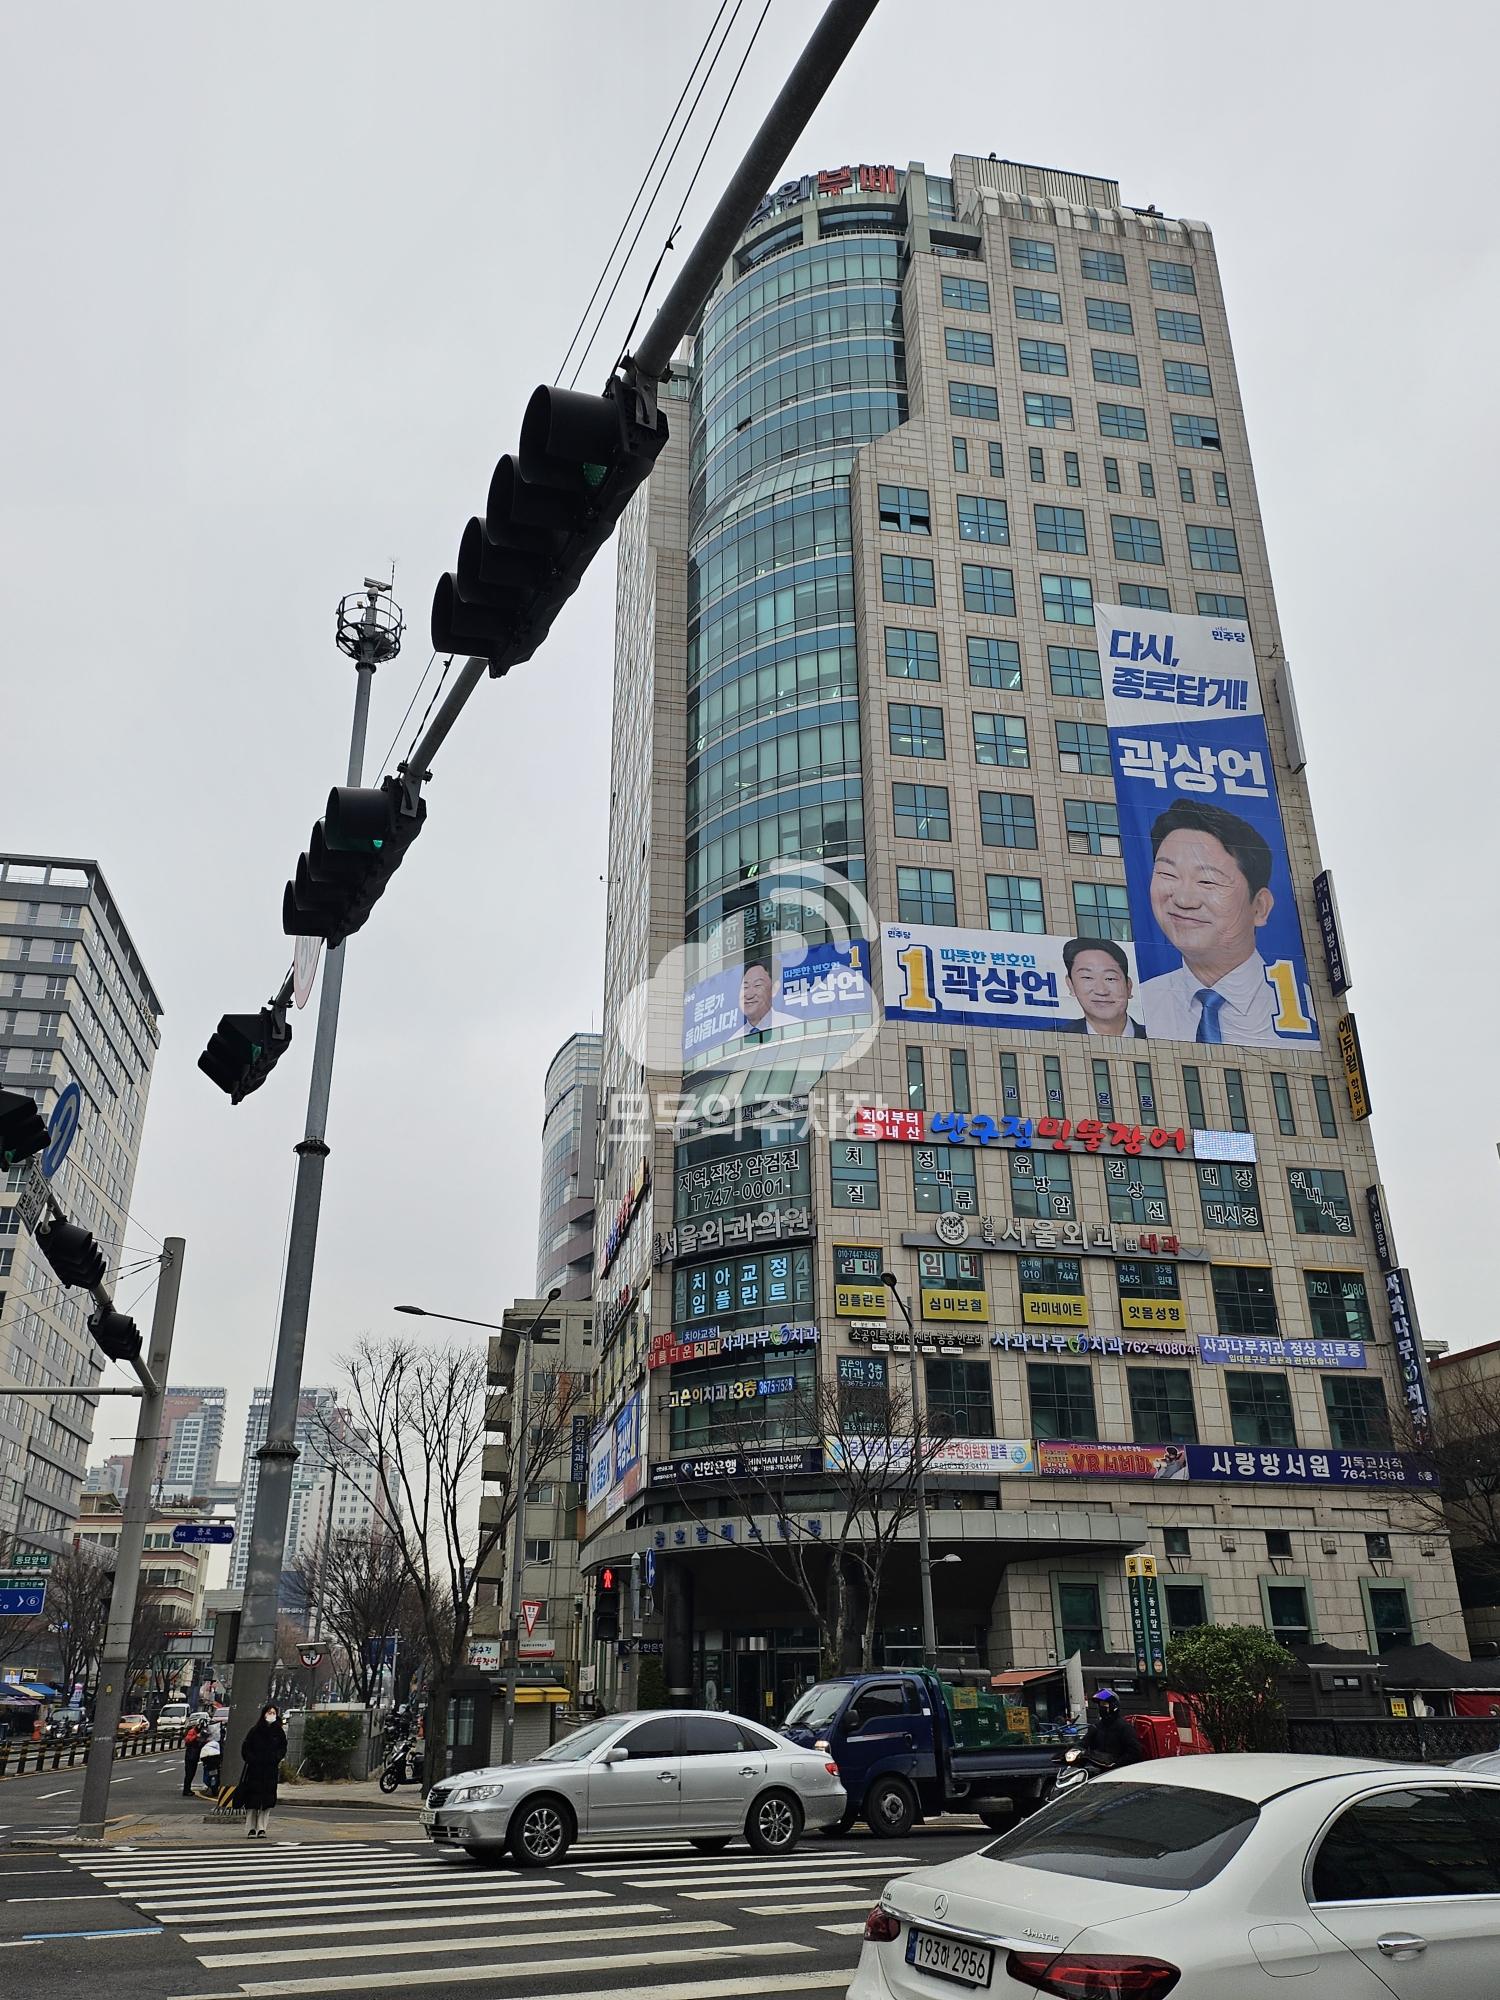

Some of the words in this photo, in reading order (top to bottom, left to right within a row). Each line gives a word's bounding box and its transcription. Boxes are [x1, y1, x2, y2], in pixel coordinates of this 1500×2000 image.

[1109, 628, 1180, 669] 다시,
[1211, 629, 1246, 643] 민주당
[1111, 665, 1248, 711] 종로답게!
[1117, 737, 1270, 798] 곽상언
[887, 928, 912, 940] 민주당
[848, 945, 862, 968] 1
[940, 949, 987, 966] 따뜻한
[990, 951, 1036, 968] 변호인
[783, 970, 865, 1007] 곽상언
[898, 944, 937, 1013] 1
[941, 964, 1059, 1007] 곽상언
[693, 993, 725, 1021] 종로가
[1265, 959, 1313, 1034] 1
[685, 1007, 739, 1050] 돌아옵니다!
[1339, 1017, 1358, 1075] 에듀윌
[1351, 1078, 1363, 1105] 학원
[862, 1109, 920, 1126] 치어부터
[862, 1124, 921, 1140] 국내산
[1038, 1115, 1186, 1154] 민물장어
[747, 1149, 800, 1174] 암검진
[917, 1150, 974, 1209] 정맥류
[1013, 1155, 1071, 1216] 유방암
[1107, 1159, 1168, 1222] 갑상선
[1290, 1171, 1352, 1233] 위내시경
[1206, 1204, 1259, 1227] 내시경
[662, 1206, 812, 1257] 서울외과의원
[1001, 1219, 1119, 1252] 서울외과
[1140, 1231, 1181, 1255] 내과
[691, 1256, 788, 1291] 치아교정
[841, 1258, 878, 1276] 임대
[923, 1251, 980, 1279] 임대
[692, 1283, 788, 1315] 임플란트
[838, 1291, 886, 1311] 임플란트
[929, 1295, 984, 1313] 심미보철
[1030, 1299, 1083, 1317] 라미네이트
[1128, 1304, 1181, 1322] 잇몸성형
[684, 1327, 718, 1343] 치아교정
[721, 1330, 770, 1351] 사과나무
[790, 1327, 818, 1344] 치과
[992, 1332, 1068, 1354] 사과나무
[1090, 1335, 1124, 1356] 치과
[1124, 1340, 1187, 1355] 762-4080
[1203, 1338, 1285, 1356] 사과나무치과
[1290, 1340, 1317, 1357] 정상
[1321, 1341, 1362, 1358] 진료중
[840, 1367, 865, 1380] 치과
[734, 1380, 757, 1399] 3층
[693, 1459, 738, 1477] 신한은행
[1211, 1451, 1331, 1478] 사랑방서원
[1340, 1455, 1403, 1469] 기독교서적
[16, 1556, 48, 1565] 동묘앞역
[1021, 1926, 1060, 1943] 4MATIC
[952, 1948, 987, 1980] 2956
